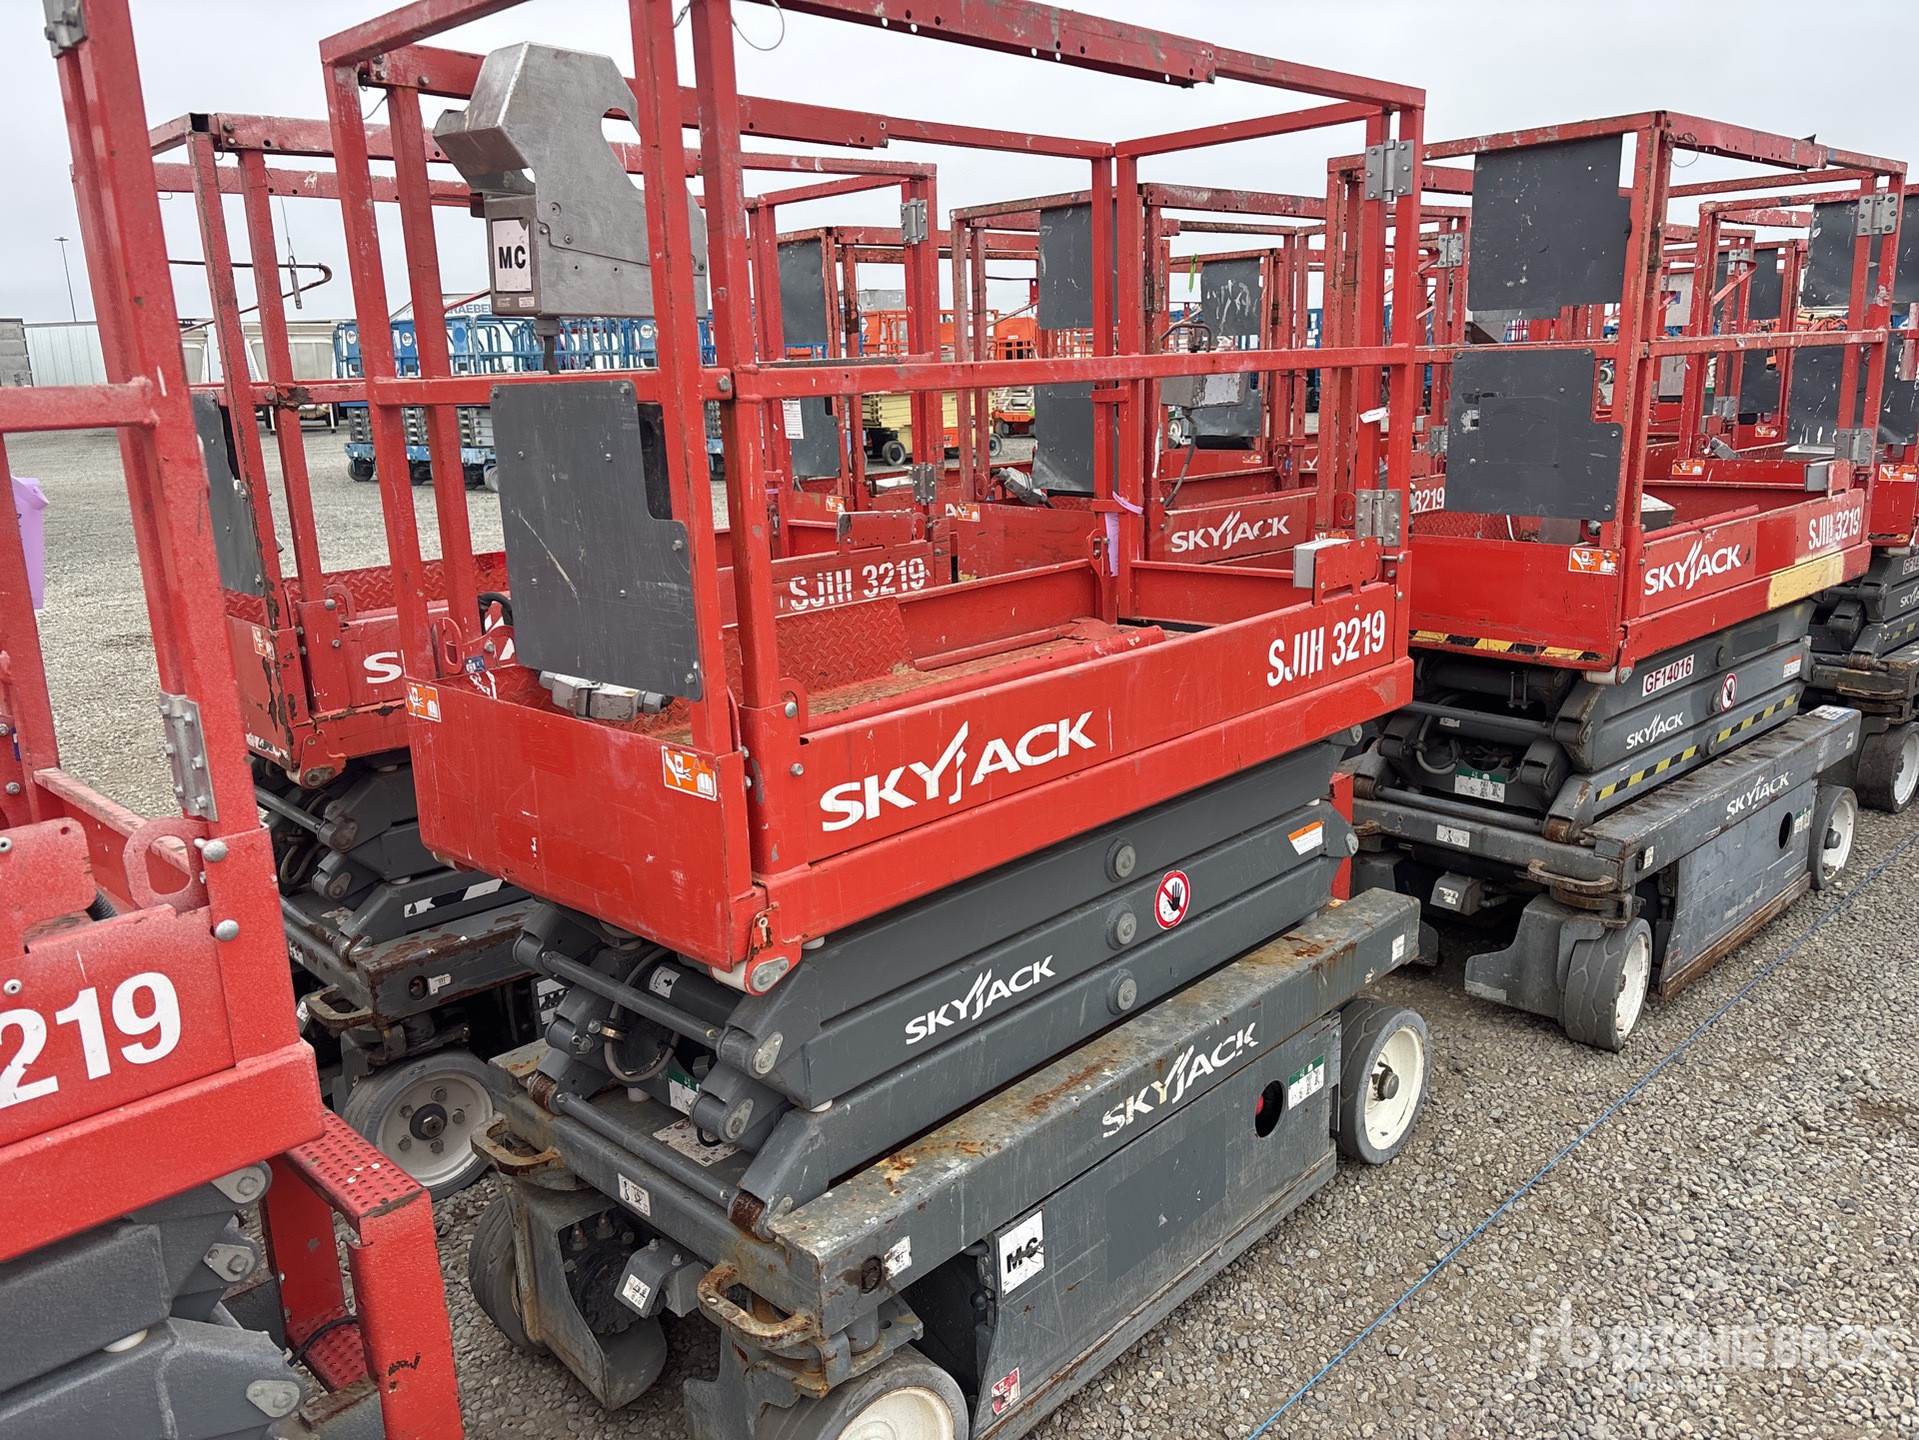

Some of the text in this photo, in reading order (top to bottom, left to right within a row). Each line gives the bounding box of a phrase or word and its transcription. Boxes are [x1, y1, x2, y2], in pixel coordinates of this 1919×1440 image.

[498, 244, 527, 270] MC
[1171, 510, 1290, 553] SKYJACK
[862, 557, 926, 598] 3219
[1644, 538, 1742, 596] SKYJACK
[1331, 609, 1386, 666] 3219
[1645, 656, 1692, 693] GF14016
[1625, 712, 1684, 750] SKYJACK
[819, 711, 1097, 832] SKYJACK
[904, 954, 1056, 1045] SKYJACK
[1102, 1021, 1260, 1139] SKYJACK
